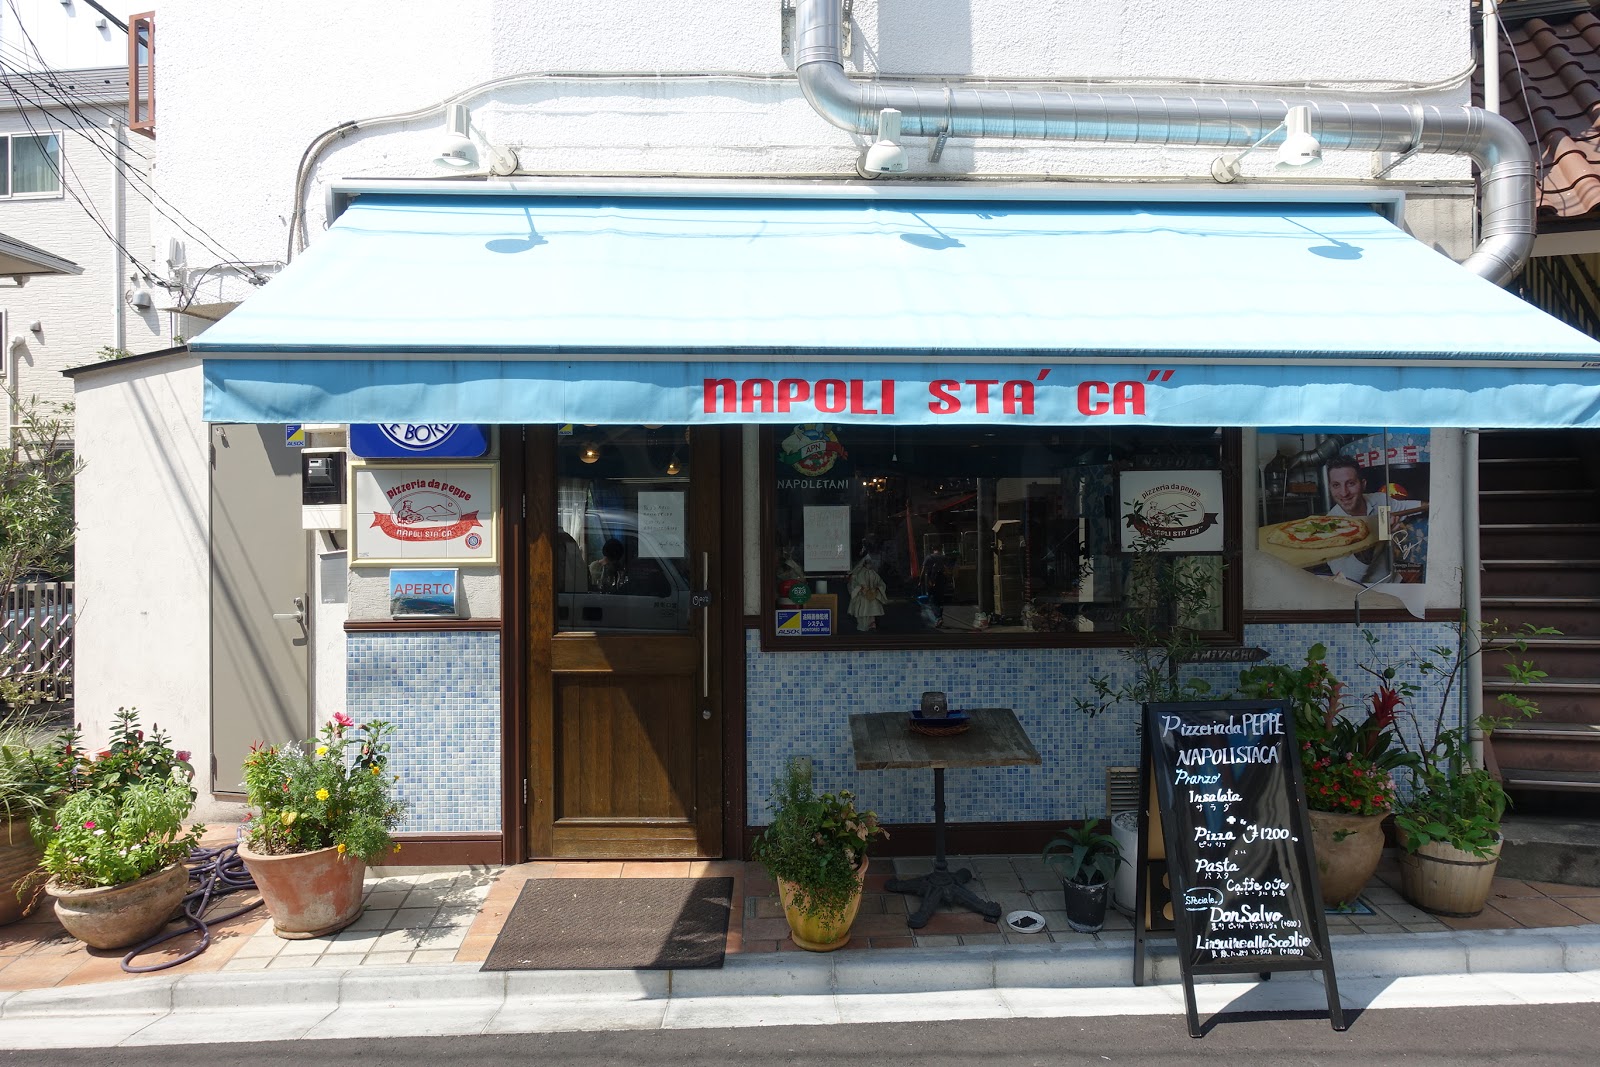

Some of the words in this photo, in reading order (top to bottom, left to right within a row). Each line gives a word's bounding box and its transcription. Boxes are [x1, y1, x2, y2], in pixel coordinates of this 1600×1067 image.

[703, 378, 895, 415] NAPOLI
[805, 443, 821, 454] APN
[386, 479, 426, 499] pizzeria
[428, 479, 440, 488] da
[441, 482, 472, 501] peppe
[777, 479, 849, 489] NAPOLETANI
[1141, 483, 1170, 499] pizzeria
[1180, 485, 1201, 498] peppe
[396, 529, 423, 538] NAPOLI
[394, 583, 453, 595] APERTO
[1242, 713, 1285, 736] PEPPE
[1176, 749, 1235, 766] NAPOLI
[1188, 788, 1243, 803] Insalata
[1196, 803, 1232, 812] サラダ
[1194, 826, 1237, 841] Pizza
[1195, 857, 1240, 873] Pasta
[1210, 907, 1241, 923] Don
[1239, 904, 1283, 923] Salvo
